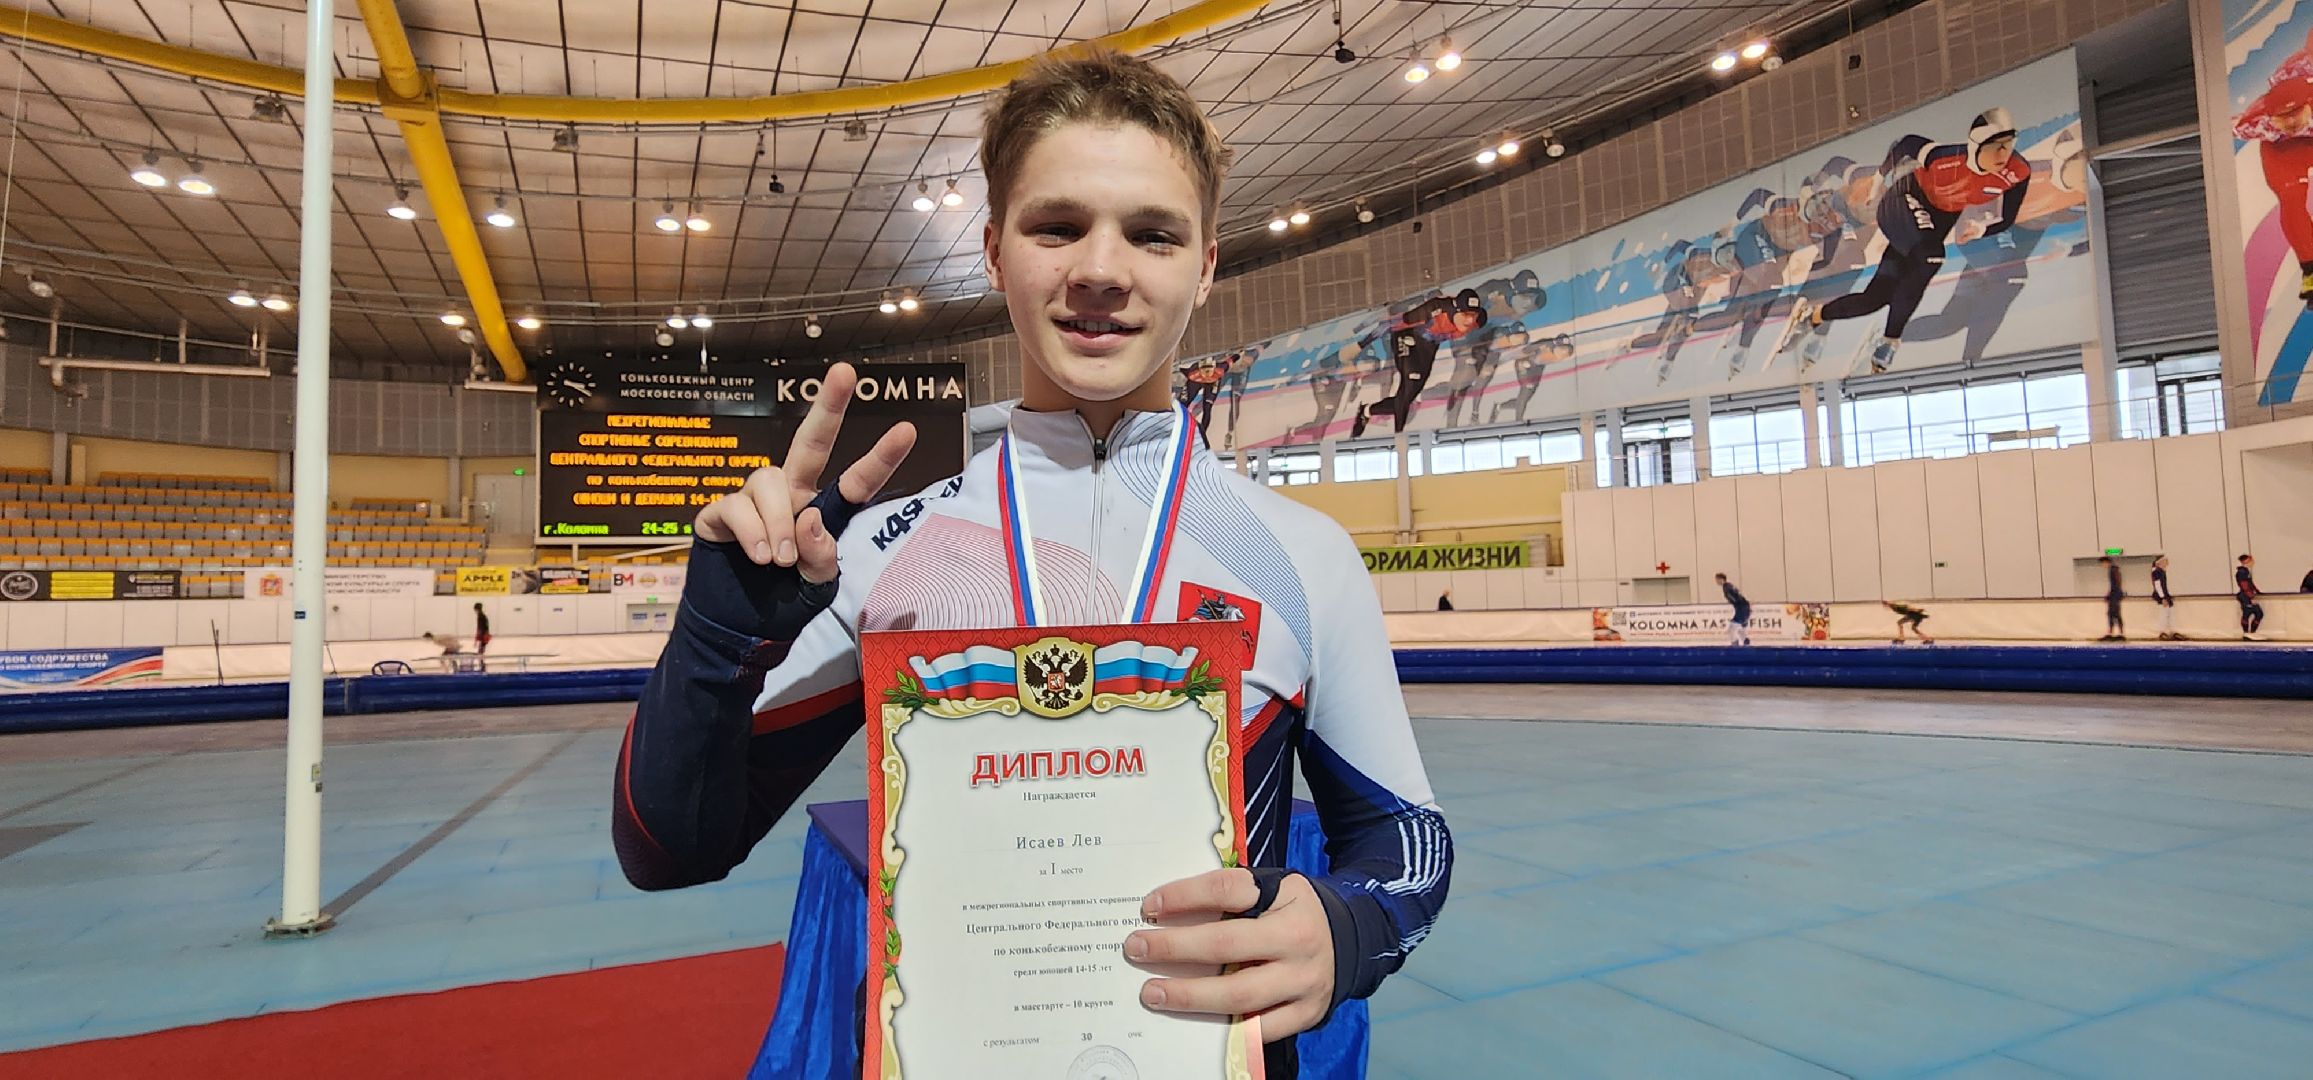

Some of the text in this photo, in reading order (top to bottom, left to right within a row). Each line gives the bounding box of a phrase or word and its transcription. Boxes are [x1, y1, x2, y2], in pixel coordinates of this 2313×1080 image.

[621, 373, 754, 387] КОНЬКОБЕЖНЫЙ ЦЕНТР
[621, 388, 755, 401] МОСКОВСКОЙ ОБЛАСТИ
[777, 376, 964, 402] КООМНА
[641, 522, 678, 535] 24-25
[1434, 545, 1521, 569] ЖИЗНИ
[1629, 619, 1698, 631] KOLOMNA
[1702, 618, 1731, 629] TAS
[30, 652, 109, 665] СОДРУЖЕСТВА
[971, 747, 1145, 787] ДИПЛОМ
[1023, 790, 1096, 802] Награждается
[1016, 834, 1102, 850] Исаев Лев
[1060, 867, 1084, 875] место
[969, 901, 1045, 912] межрегиональных
[1047, 898, 1097, 909] спортивных
[966, 921, 1042, 935] Центрального
[1044, 918, 1118, 934] Федерального
[994, 948, 1006, 956] по
[1009, 944, 1093, 957] конькобежному
[1013, 969, 1037, 979] среди
[1039, 966, 1073, 976] юношей
[1075, 964, 1097, 973] 14-15
[1073, 1000, 1083, 1008] 10
[1084, 1000, 1114, 1010] кругов
[989, 1037, 1040, 1049] результатом
[1081, 1032, 1093, 1041] 30
